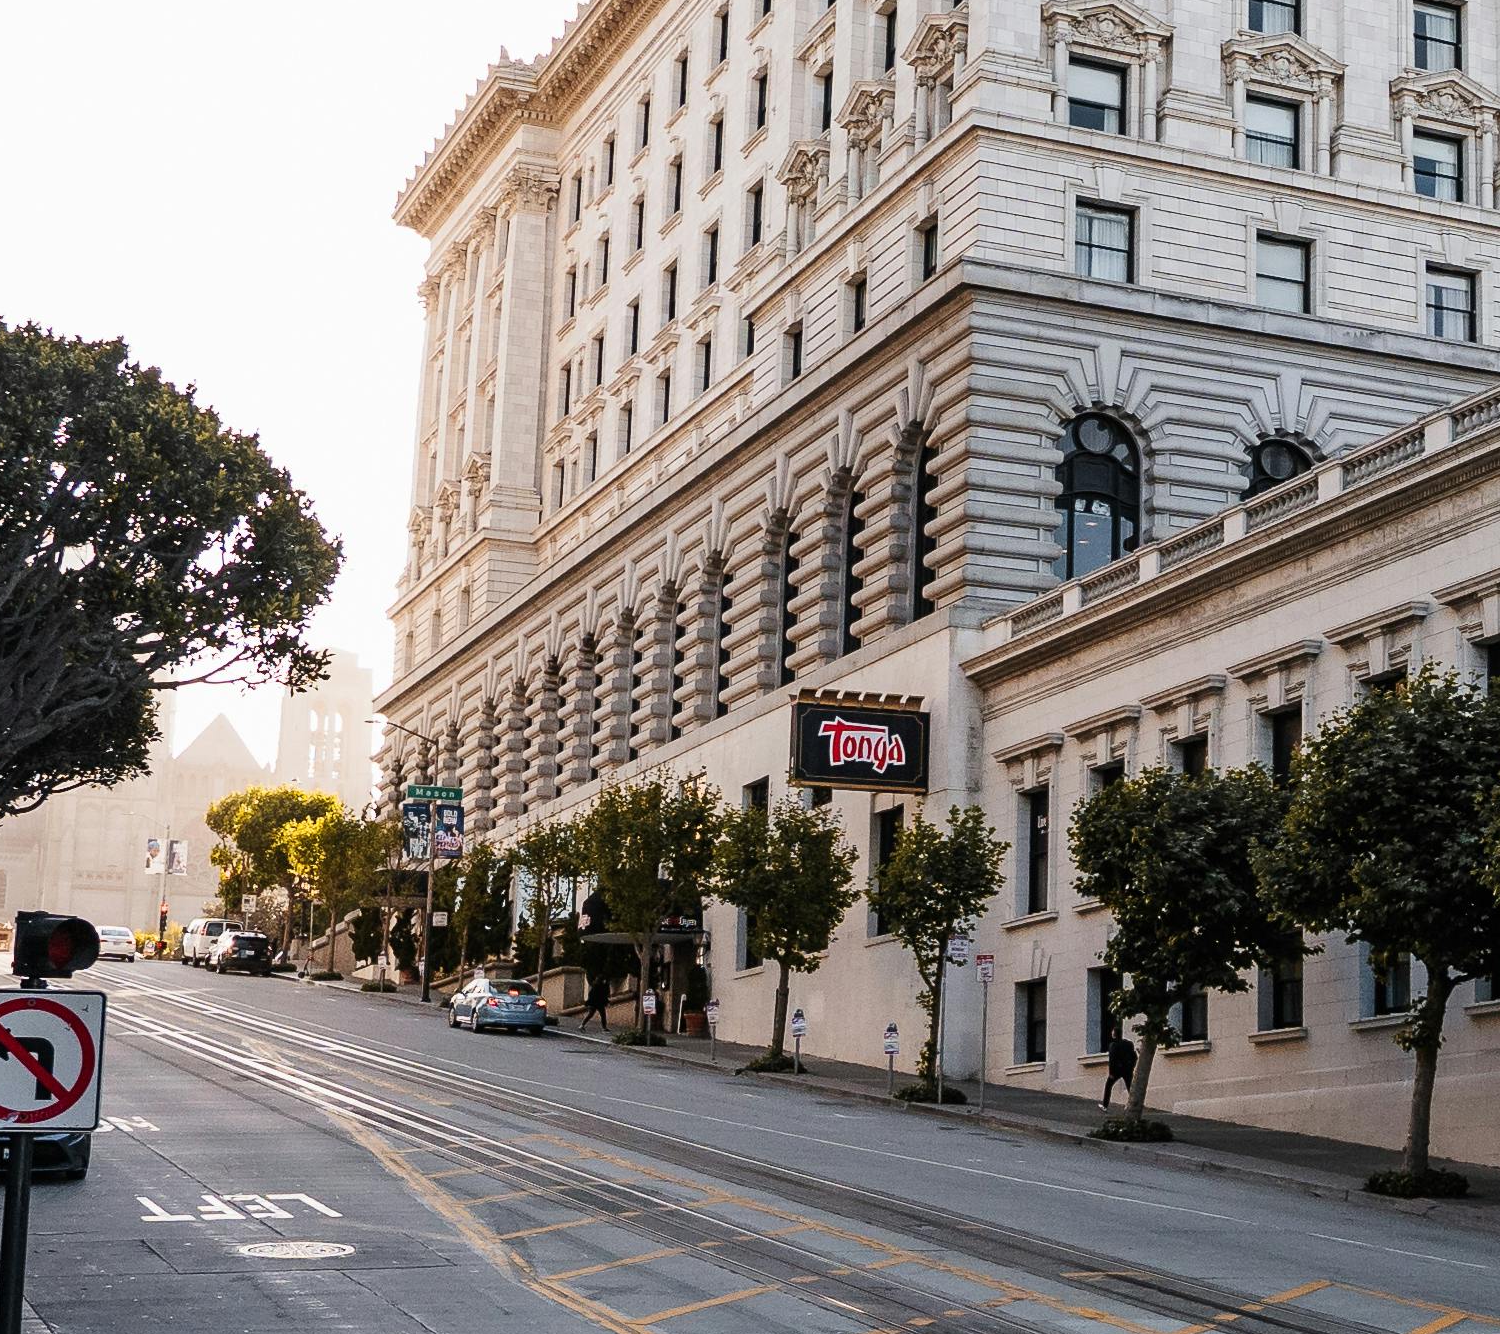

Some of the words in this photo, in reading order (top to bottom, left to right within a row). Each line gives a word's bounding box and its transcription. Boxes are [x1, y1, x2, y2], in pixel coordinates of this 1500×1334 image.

[818, 716, 906, 774] Tonga
[415, 788, 455, 799] Mason
[136, 1193, 344, 1222] LEFT
